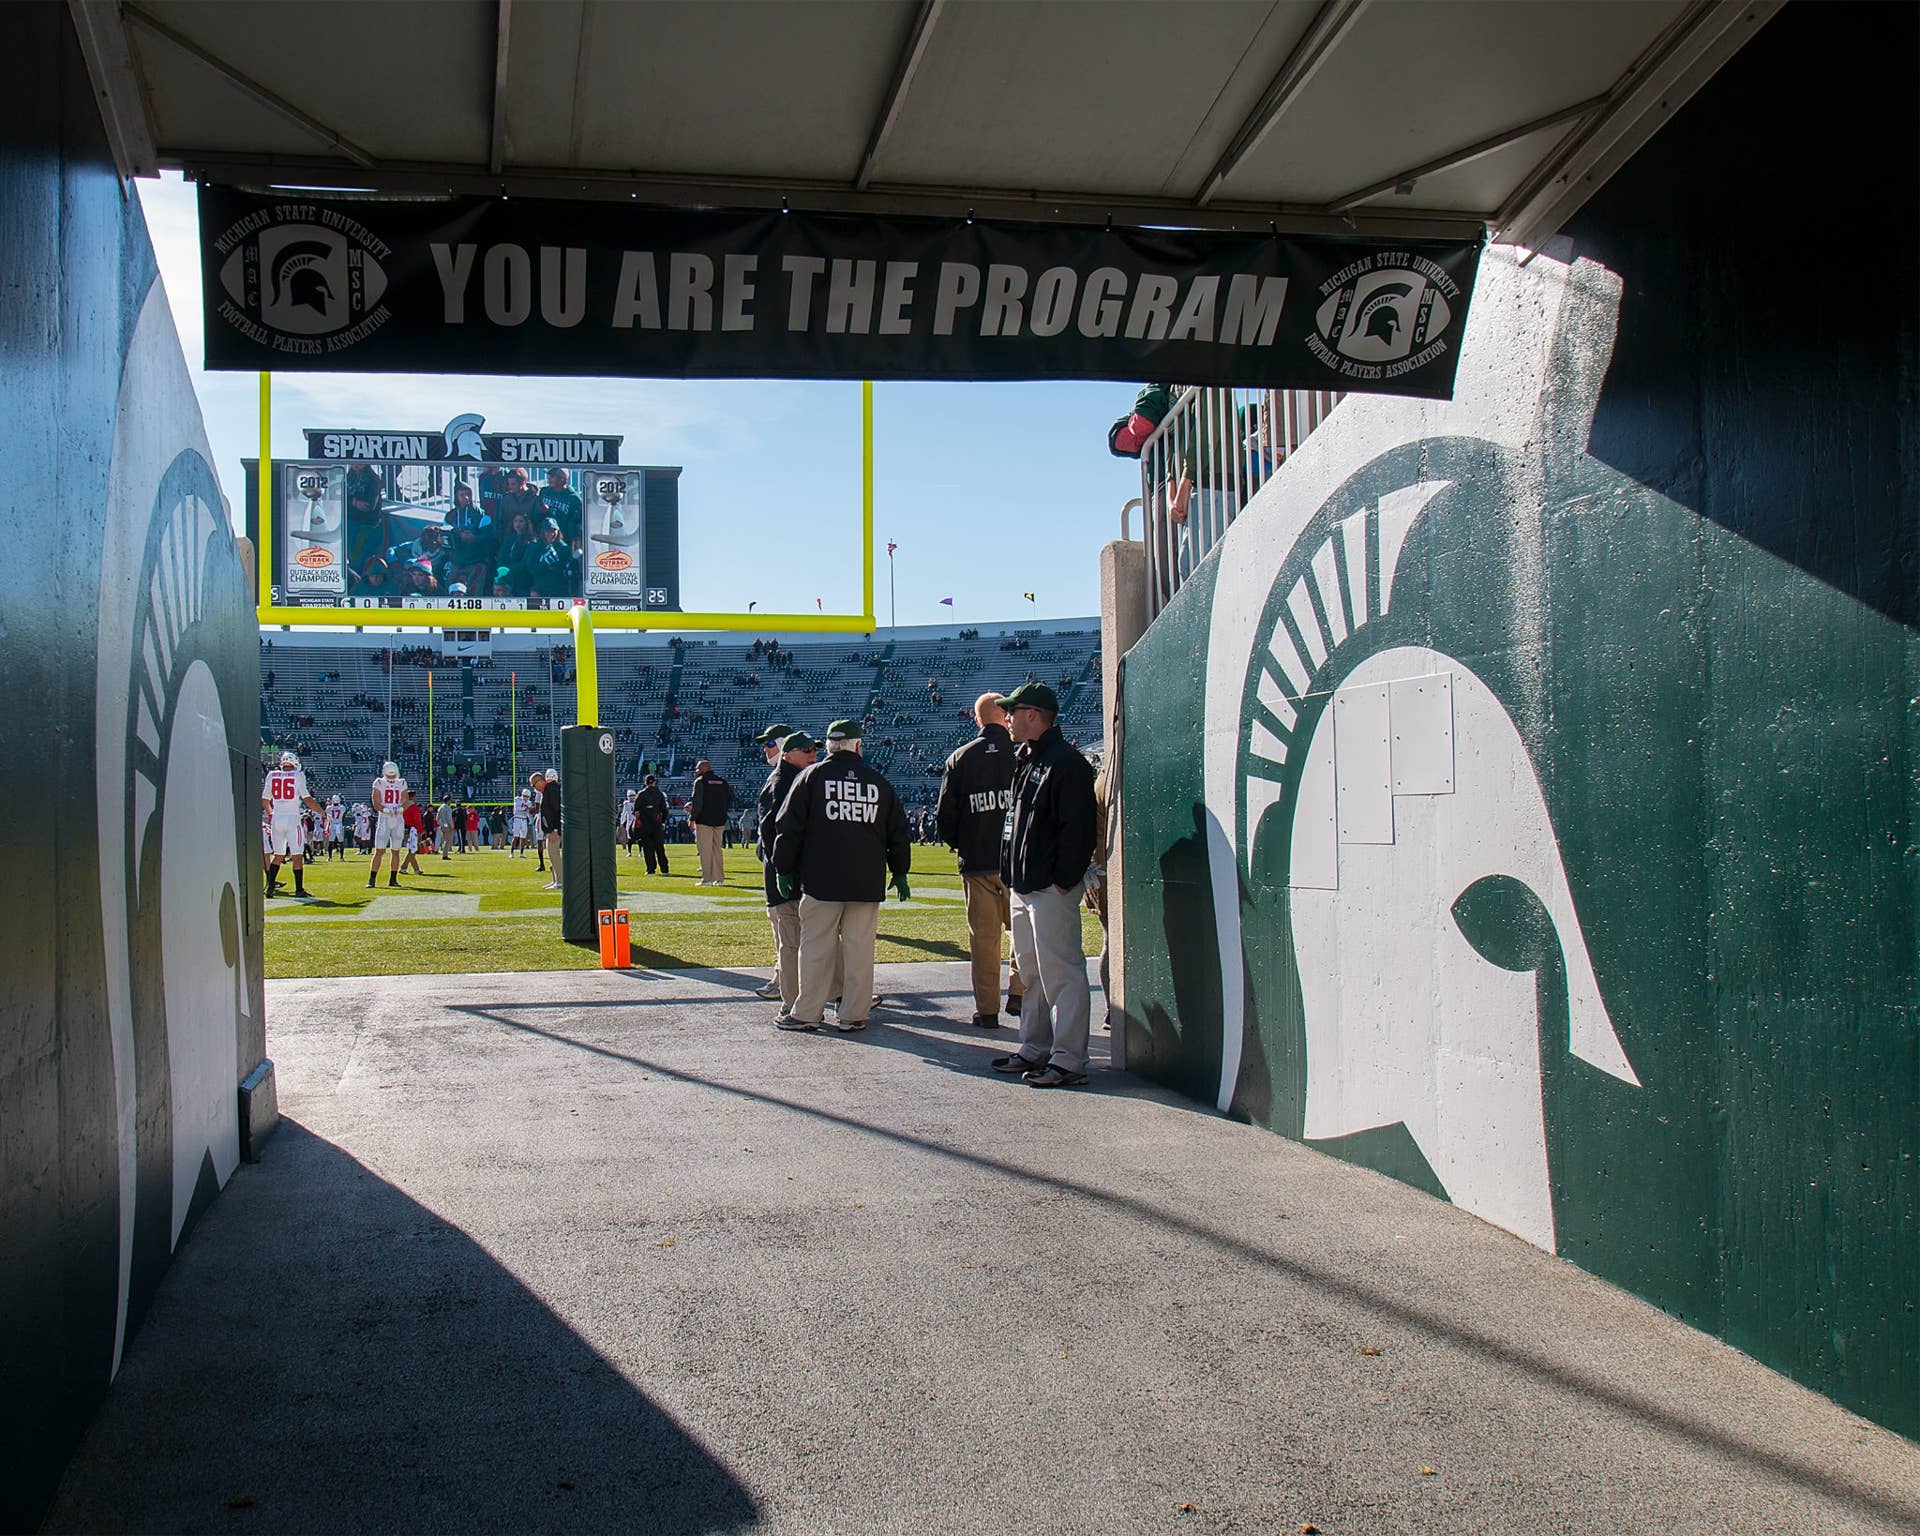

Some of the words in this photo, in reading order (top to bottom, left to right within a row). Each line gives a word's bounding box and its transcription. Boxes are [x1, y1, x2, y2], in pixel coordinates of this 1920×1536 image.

[214, 208, 271, 255] MICHIGAN
[275, 204, 317, 221] STATE
[321, 209, 392, 261] UNIVERSITY
[1318, 256, 1372, 297] MICHIGAN
[1376, 251, 1411, 267] STATE
[1412, 255, 1461, 300] UNIVERSITY
[430, 243, 587, 328] YOU
[611, 250, 758, 332] ARE
[782, 255, 919, 335] THE
[933, 262, 1289, 346] PROGRAM
[217, 301, 268, 345] FOOTBALL
[271, 334, 323, 355] PLAYERS
[326, 304, 392, 353] ASSOCIATION
[1304, 332, 1339, 370] FOOTBALL
[1339, 359, 1382, 380] PLAYERS
[1385, 338, 1448, 378] ASSOCIATION
[323, 434, 428, 460] SPARTAN
[500, 438, 604, 463] STADIUM
[300, 476, 328, 489] 2012
[600, 481, 627, 494] 2012
[290, 575, 340, 583] CHAMPIONS
[590, 577, 639, 585] CHAMPIONS
[447, 599, 483, 609] 41:08
[557, 600, 565, 610] 0
[648, 590, 665, 603] 25
[271, 778, 295, 800] 86
[384, 789, 400, 804] 81
[824, 780, 879, 804] FIELD
[825, 800, 879, 824] CREW
[969, 790, 995, 814] FIELD
[331, 809, 341, 820] 17
